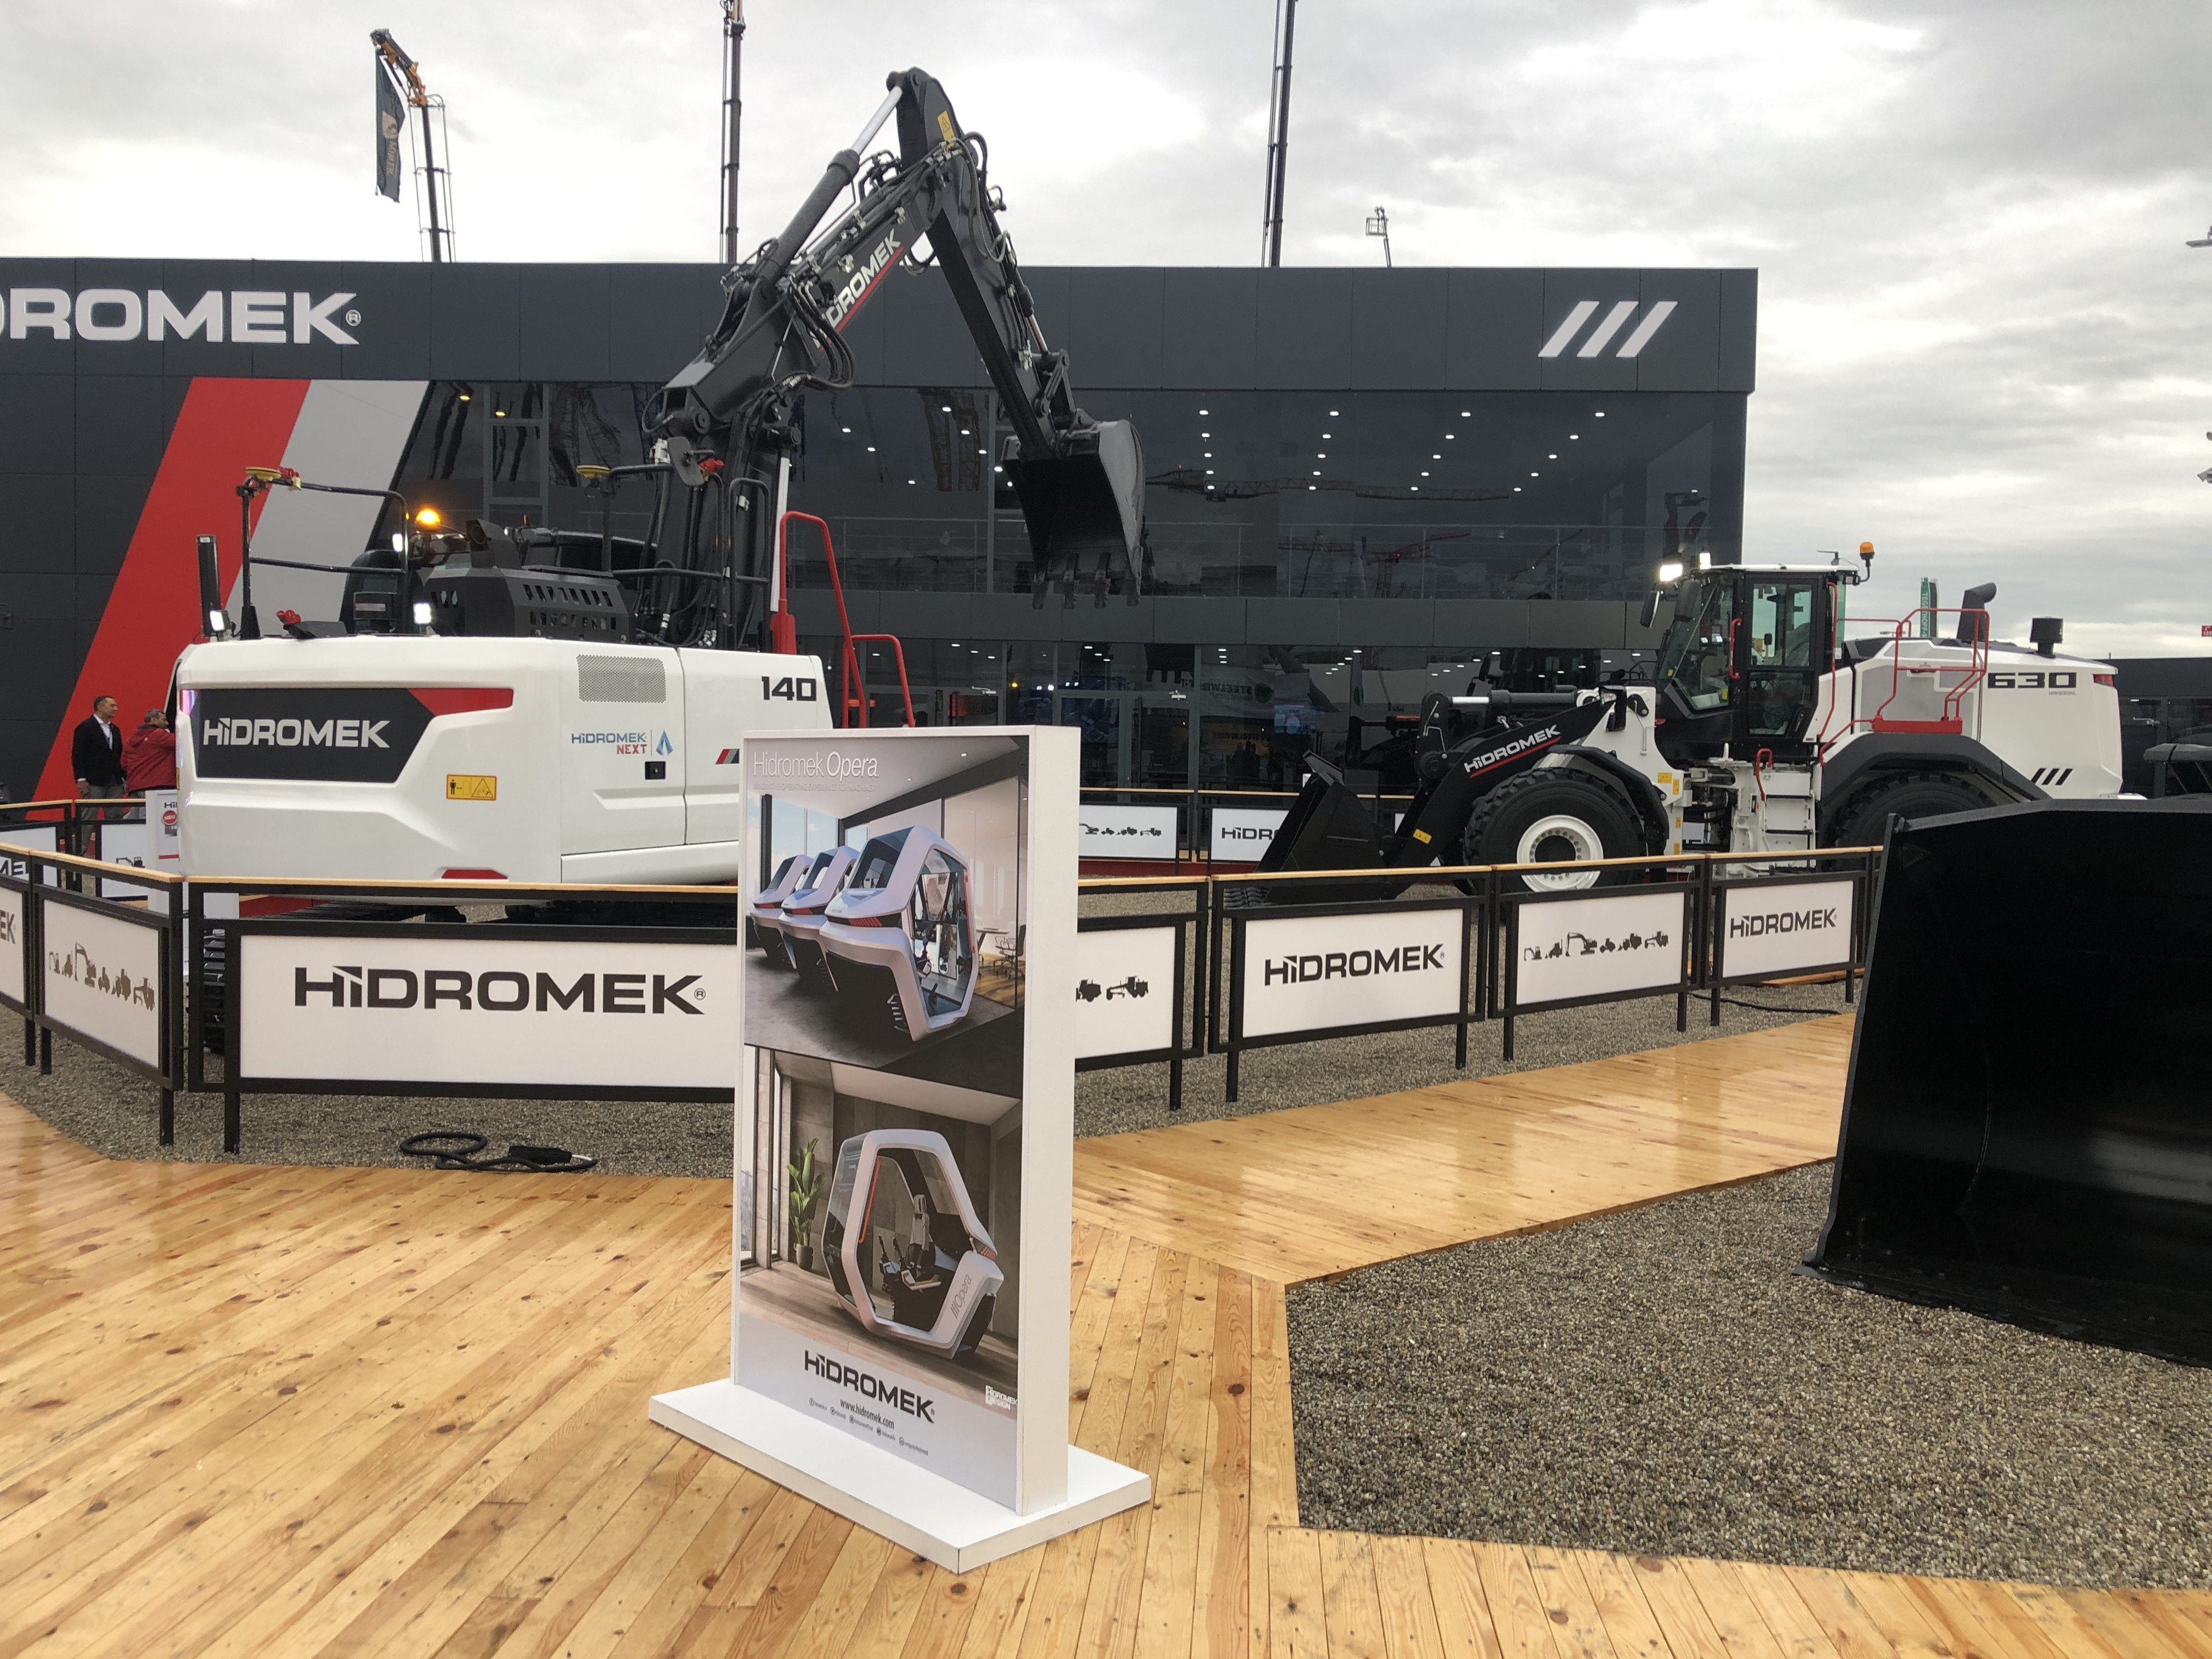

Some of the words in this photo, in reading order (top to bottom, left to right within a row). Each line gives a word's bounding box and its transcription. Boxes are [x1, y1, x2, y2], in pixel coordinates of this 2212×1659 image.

[0, 288, 360, 345] ROMEK
[761, 676, 816, 701] 140
[1988, 672, 2076, 688] 630
[617, 744, 647, 754] NEXT
[754, 752, 824, 777] Hidromek
[840, 1399, 895, 1430] www.hidromek.com
